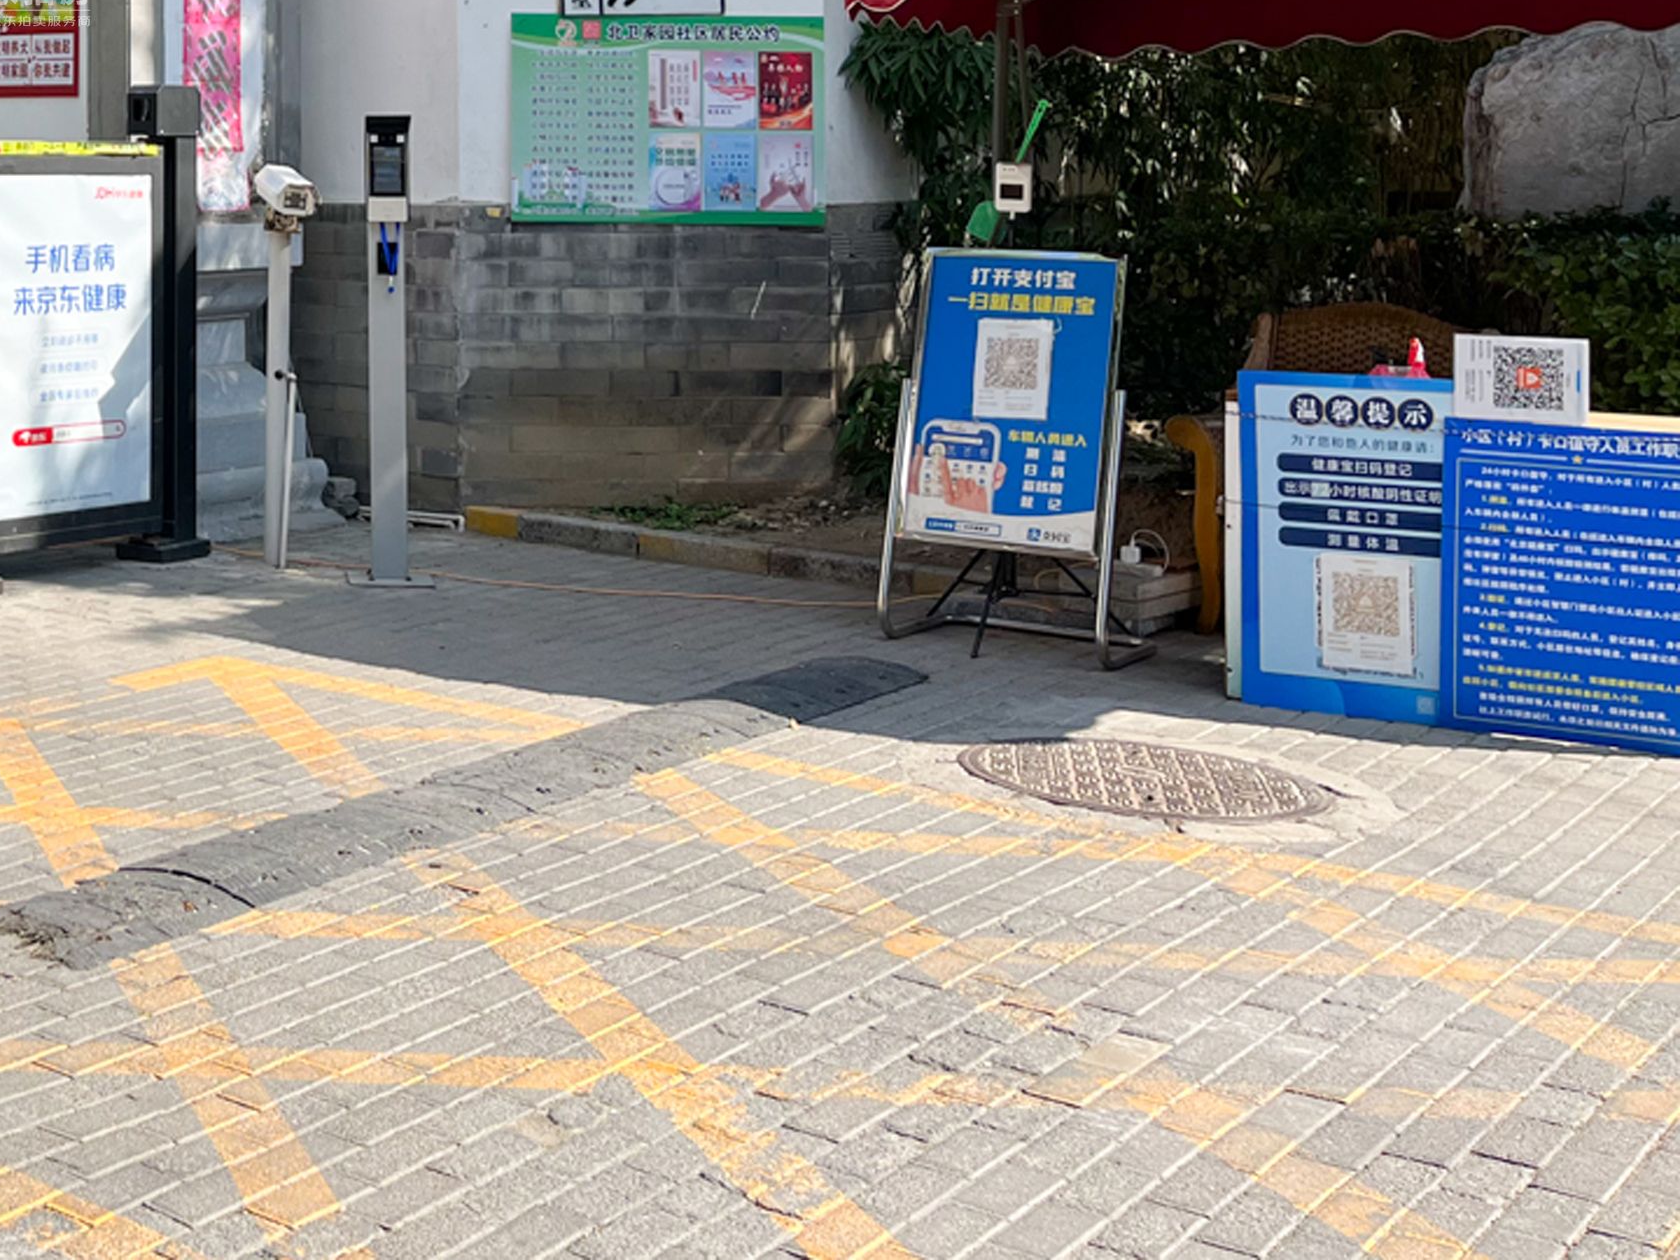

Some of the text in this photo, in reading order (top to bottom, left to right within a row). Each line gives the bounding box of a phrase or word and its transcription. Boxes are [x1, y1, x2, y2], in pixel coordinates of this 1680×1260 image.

[607, 24, 780, 43] 北卫家园社区居民公约
[25, 243, 116, 274] 手机看病
[970, 266, 1077, 290] 打开支付宝
[13, 283, 127, 316] 来京东健康
[947, 292, 1095, 316] 一扫就是健康宝
[1295, 397, 1428, 426] 温馨提示
[1311, 457, 1413, 477] 健康宝扫码登记
[1327, 533, 1400, 551] 测量体温
